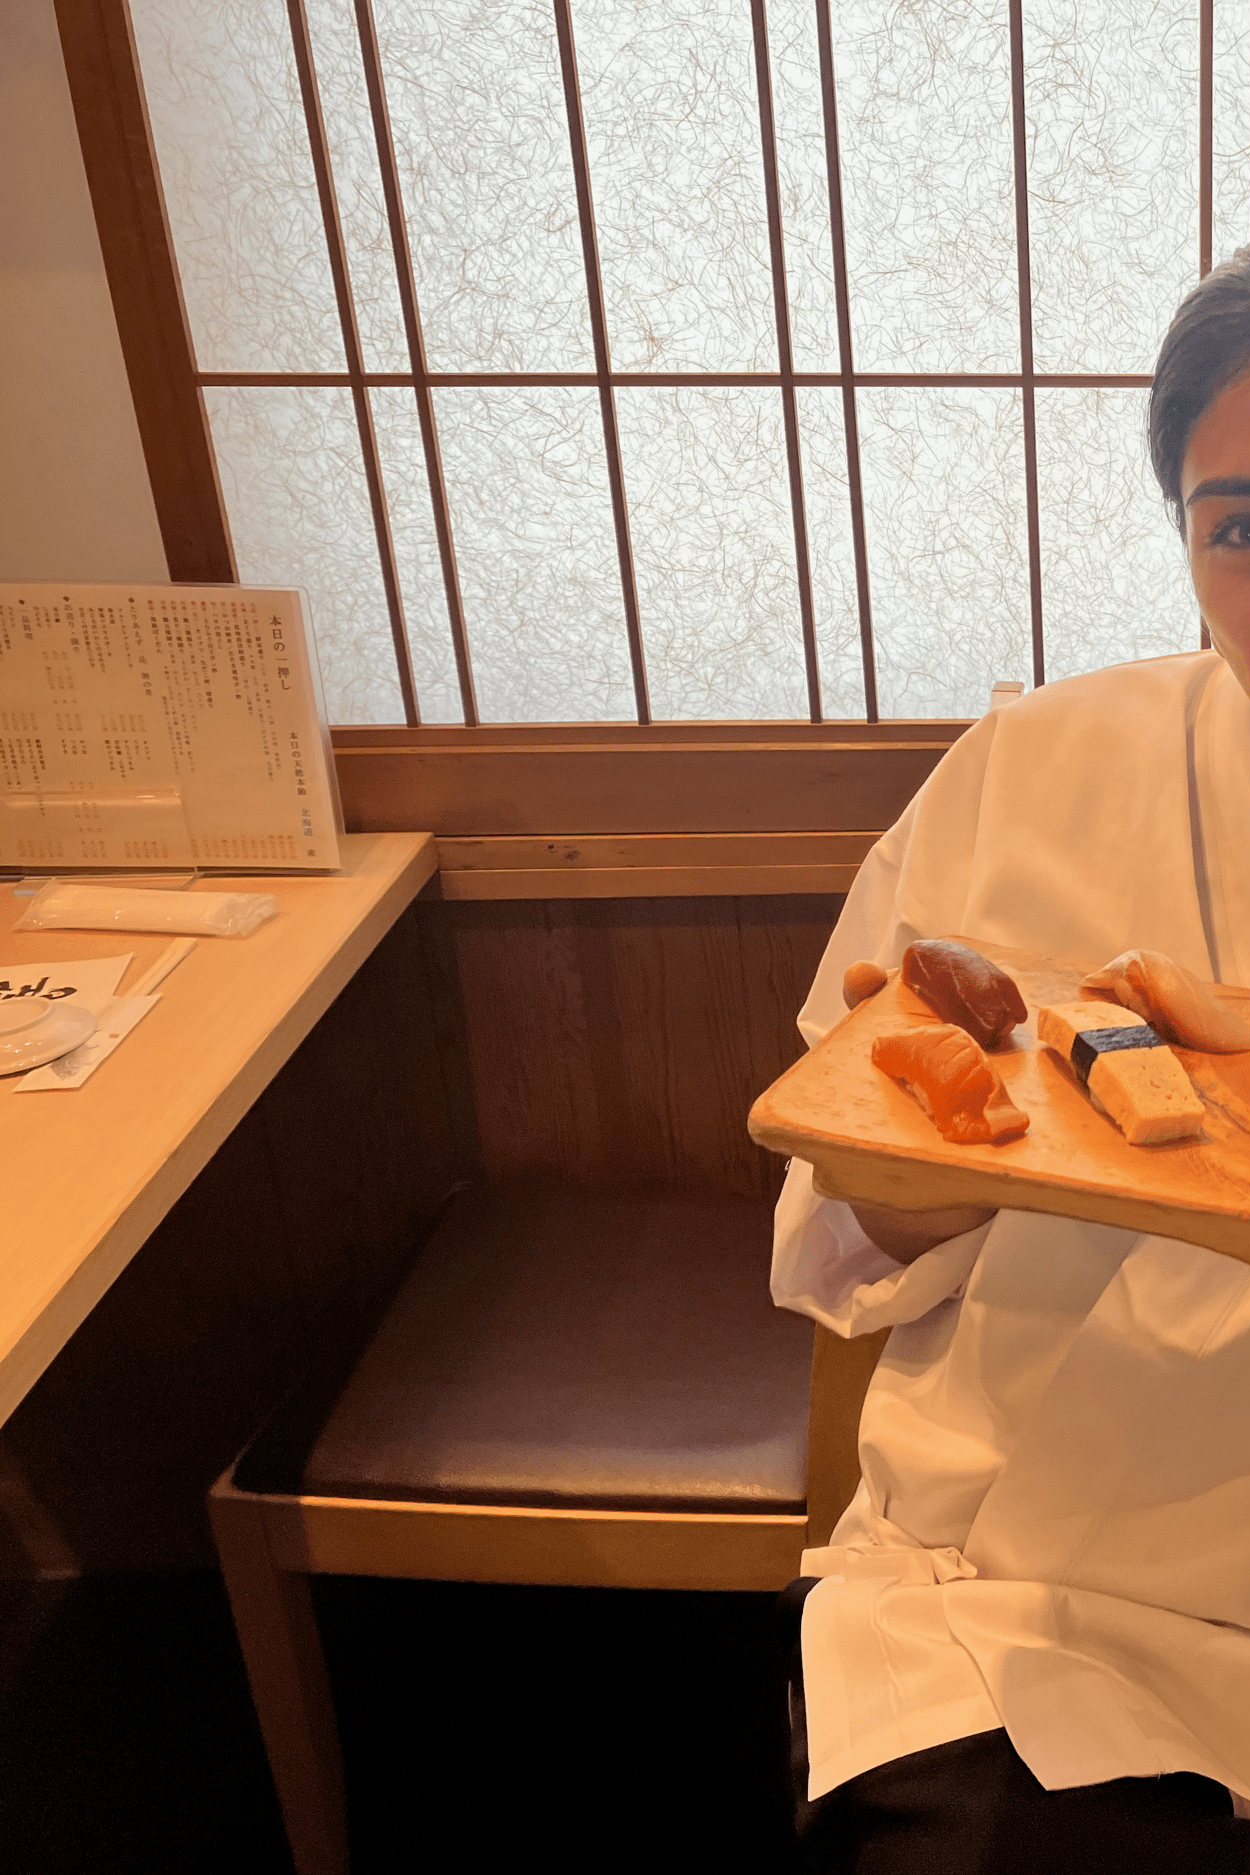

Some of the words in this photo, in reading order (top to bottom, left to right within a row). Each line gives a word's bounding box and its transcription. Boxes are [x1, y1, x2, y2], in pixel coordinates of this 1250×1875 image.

[269, 614, 291, 690] 本日の一押し
